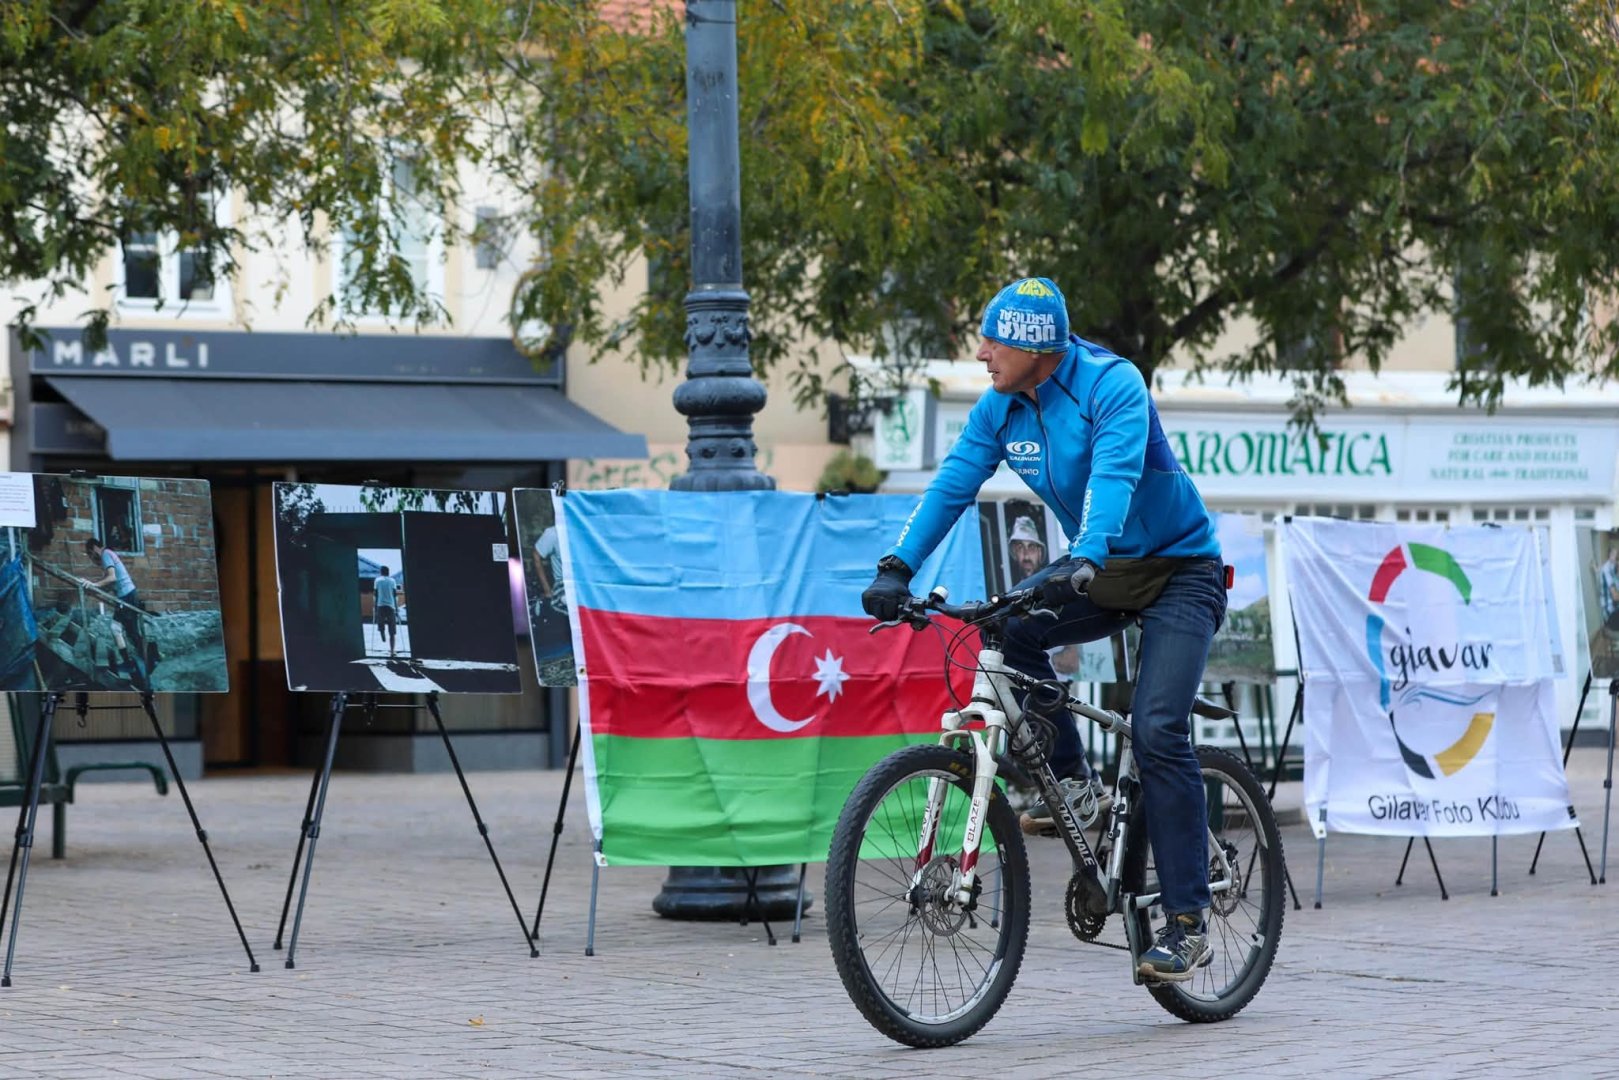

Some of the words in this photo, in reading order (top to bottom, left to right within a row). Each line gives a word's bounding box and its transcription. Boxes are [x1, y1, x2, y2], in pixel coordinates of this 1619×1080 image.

[1000, 309, 1054, 325] VERTICAL
[53, 340, 208, 368] MARLI
[1453, 432, 1513, 446] CROATIAN
[1517, 432, 1577, 446] PRODUCTS
[1168, 430, 1393, 476] AROMATICA
[1448, 451, 1470, 463] FOR
[1474, 451, 1503, 463] CARE
[1508, 451, 1531, 463] AND
[1534, 451, 1579, 463] HEALTH
[1430, 468, 1485, 480] NATURAL
[1514, 468, 1589, 480] TRADITIONAL
[967, 799, 981, 842] BLAZE
[1432, 800, 1473, 824] Foto
